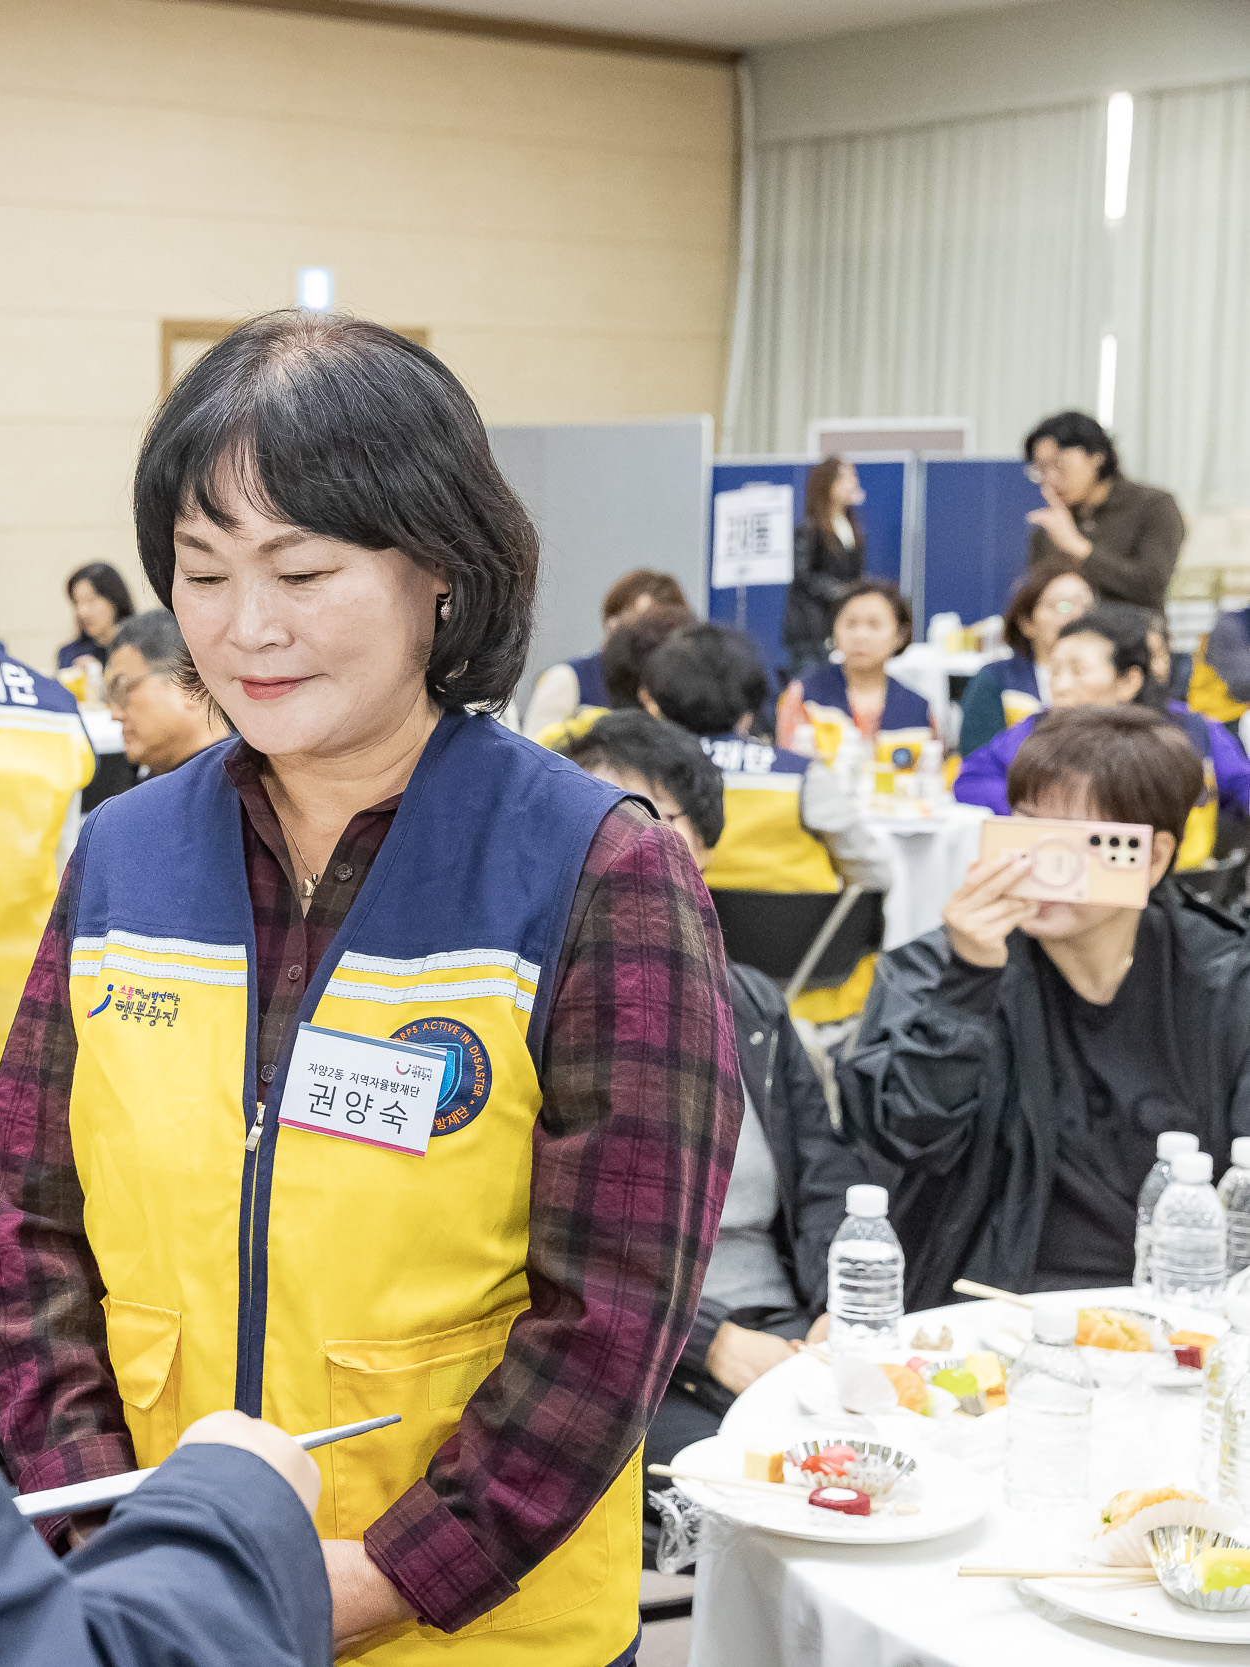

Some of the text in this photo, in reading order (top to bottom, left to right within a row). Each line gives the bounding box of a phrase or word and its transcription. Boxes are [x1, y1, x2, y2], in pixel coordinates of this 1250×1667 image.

[701, 737, 776, 773] 재단
[115, 1000, 178, 1027] 행복광진
[422, 1021, 461, 1036] ACTIVE
[459, 1031, 473, 1045] IN
[468, 1045, 487, 1098] DISASTER
[307, 1062, 421, 1099] 자양2동 지역자율방재단
